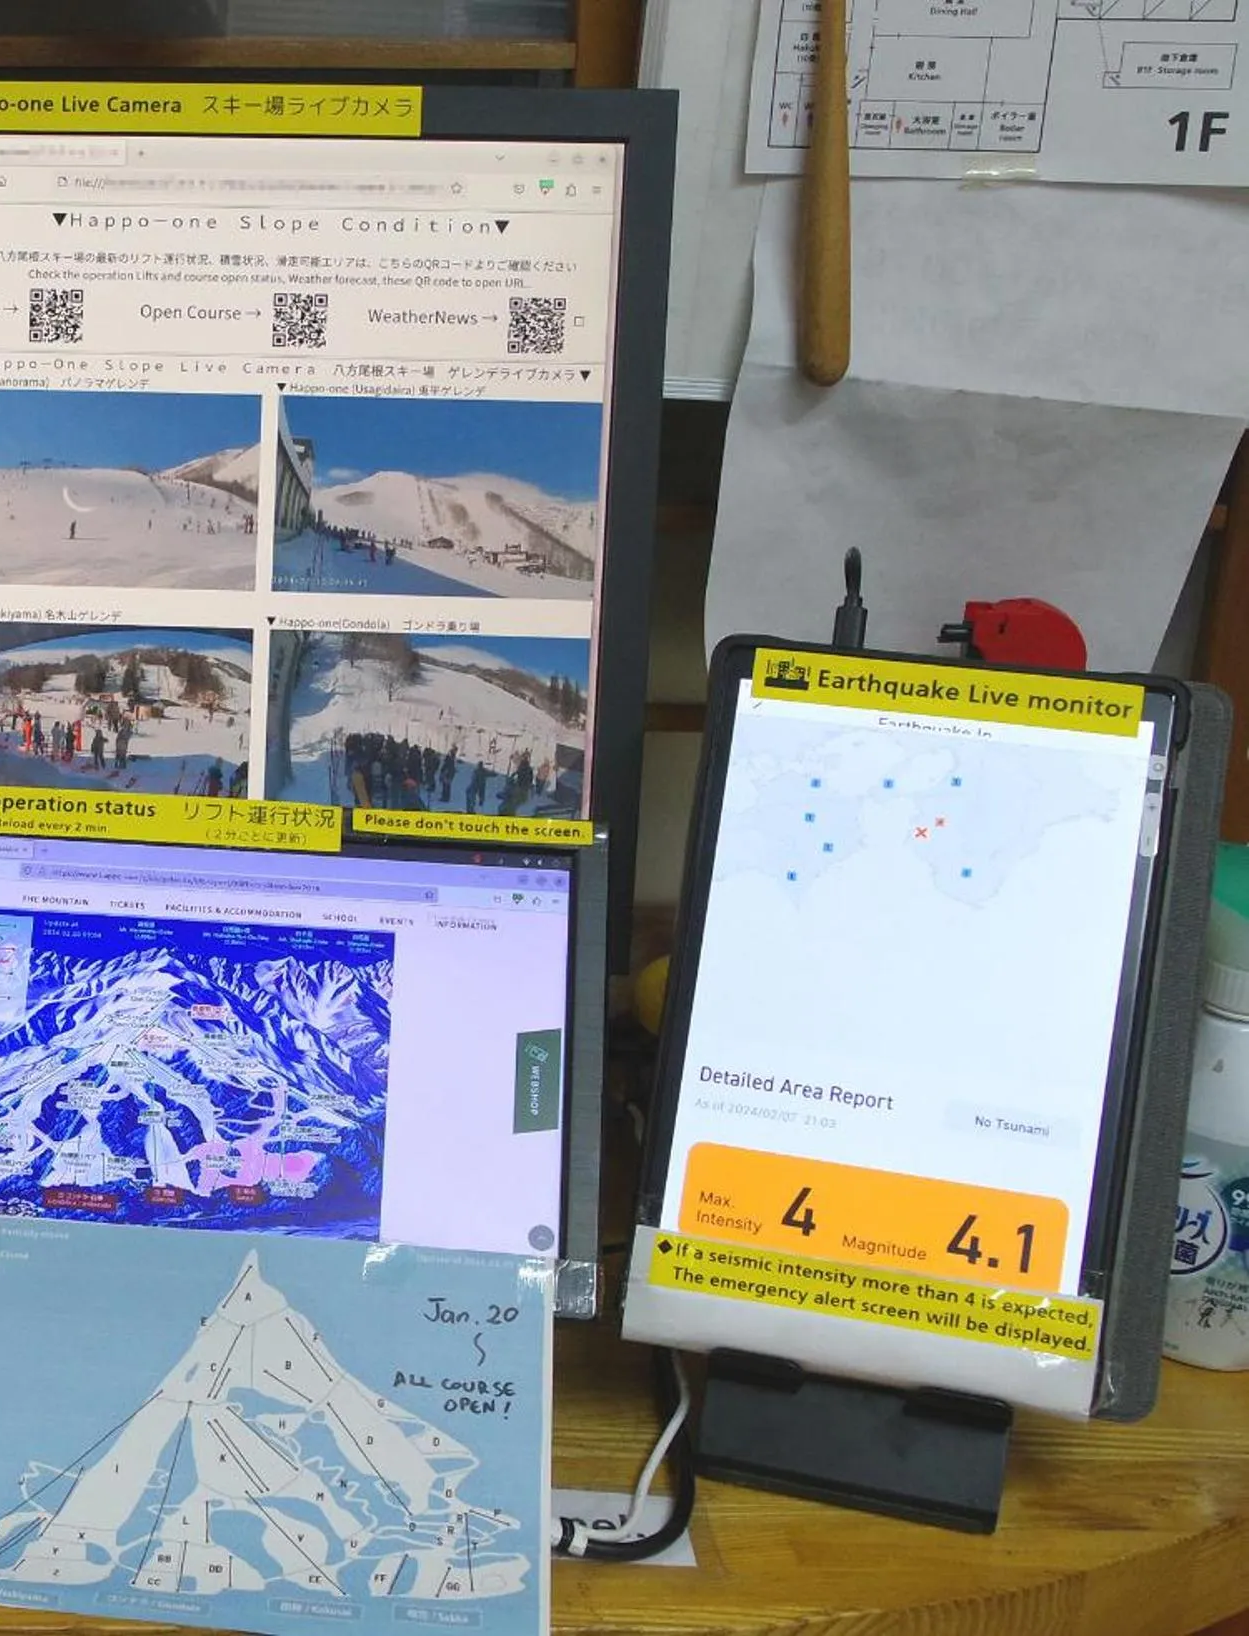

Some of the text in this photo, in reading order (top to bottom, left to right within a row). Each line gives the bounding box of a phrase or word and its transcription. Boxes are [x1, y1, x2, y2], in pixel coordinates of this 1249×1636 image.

[909, 72, 941, 81] Kitchen
[1158, 67, 1191, 75] Storage
[62, 96, 100, 113] Live
[107, 97, 181, 113] Camera
[202, 95, 413, 117] スキー場ライブカメラ
[1168, 111, 1229, 152] 1F
[70, 214, 490, 234] Happo-one Slope Condition
[29, 269, 502, 290] Check the operation and course open Weather these QR code to open
[140, 305, 241, 321] Open Course
[368, 309, 479, 325] WeatherNews
[105, 359, 163, 373] Slope
[181, 361, 227, 373] Live
[243, 362, 316, 376] Camera
[817, 669, 1133, 721] Earthquake Live monitor
[95, 797, 156, 818] status
[183, 803, 336, 830] リフト運行状況
[38, 820, 71, 833] every
[75, 823, 82, 832] 2
[365, 813, 586, 840] Please don't touch the screen.
[22, 895, 89, 907] THE MOUNTAIN
[110, 900, 146, 910] TICKETS
[323, 912, 357, 923] SCHOOL
[379, 916, 414, 926] EVENTS
[435, 919, 498, 932] INFORMATION
[531, 1066, 541, 1116] WEBSHOP
[699, 1066, 895, 1112] Detailed Area Report
[975, 1115, 1050, 1138] No Tsunami
[699, 1191, 735, 1209] Max.
[781, 1187, 817, 1237] 4
[695, 1211, 762, 1235] Intensity
[842, 1234, 927, 1262] Magnitude
[946, 1213, 1035, 1274] 4.1
[675, 1242, 1094, 1328] If a seismic intensity more than 4 is expected,
[245, 1292, 252, 1301] A
[424, 1298, 519, 1325] Jan. 20
[672, 1265, 1091, 1354] The emergency alert screen will be displayed.
[285, 1360, 292, 1370] B
[394, 1371, 516, 1396] ALL COURSE
[279, 1420, 286, 1429] H
